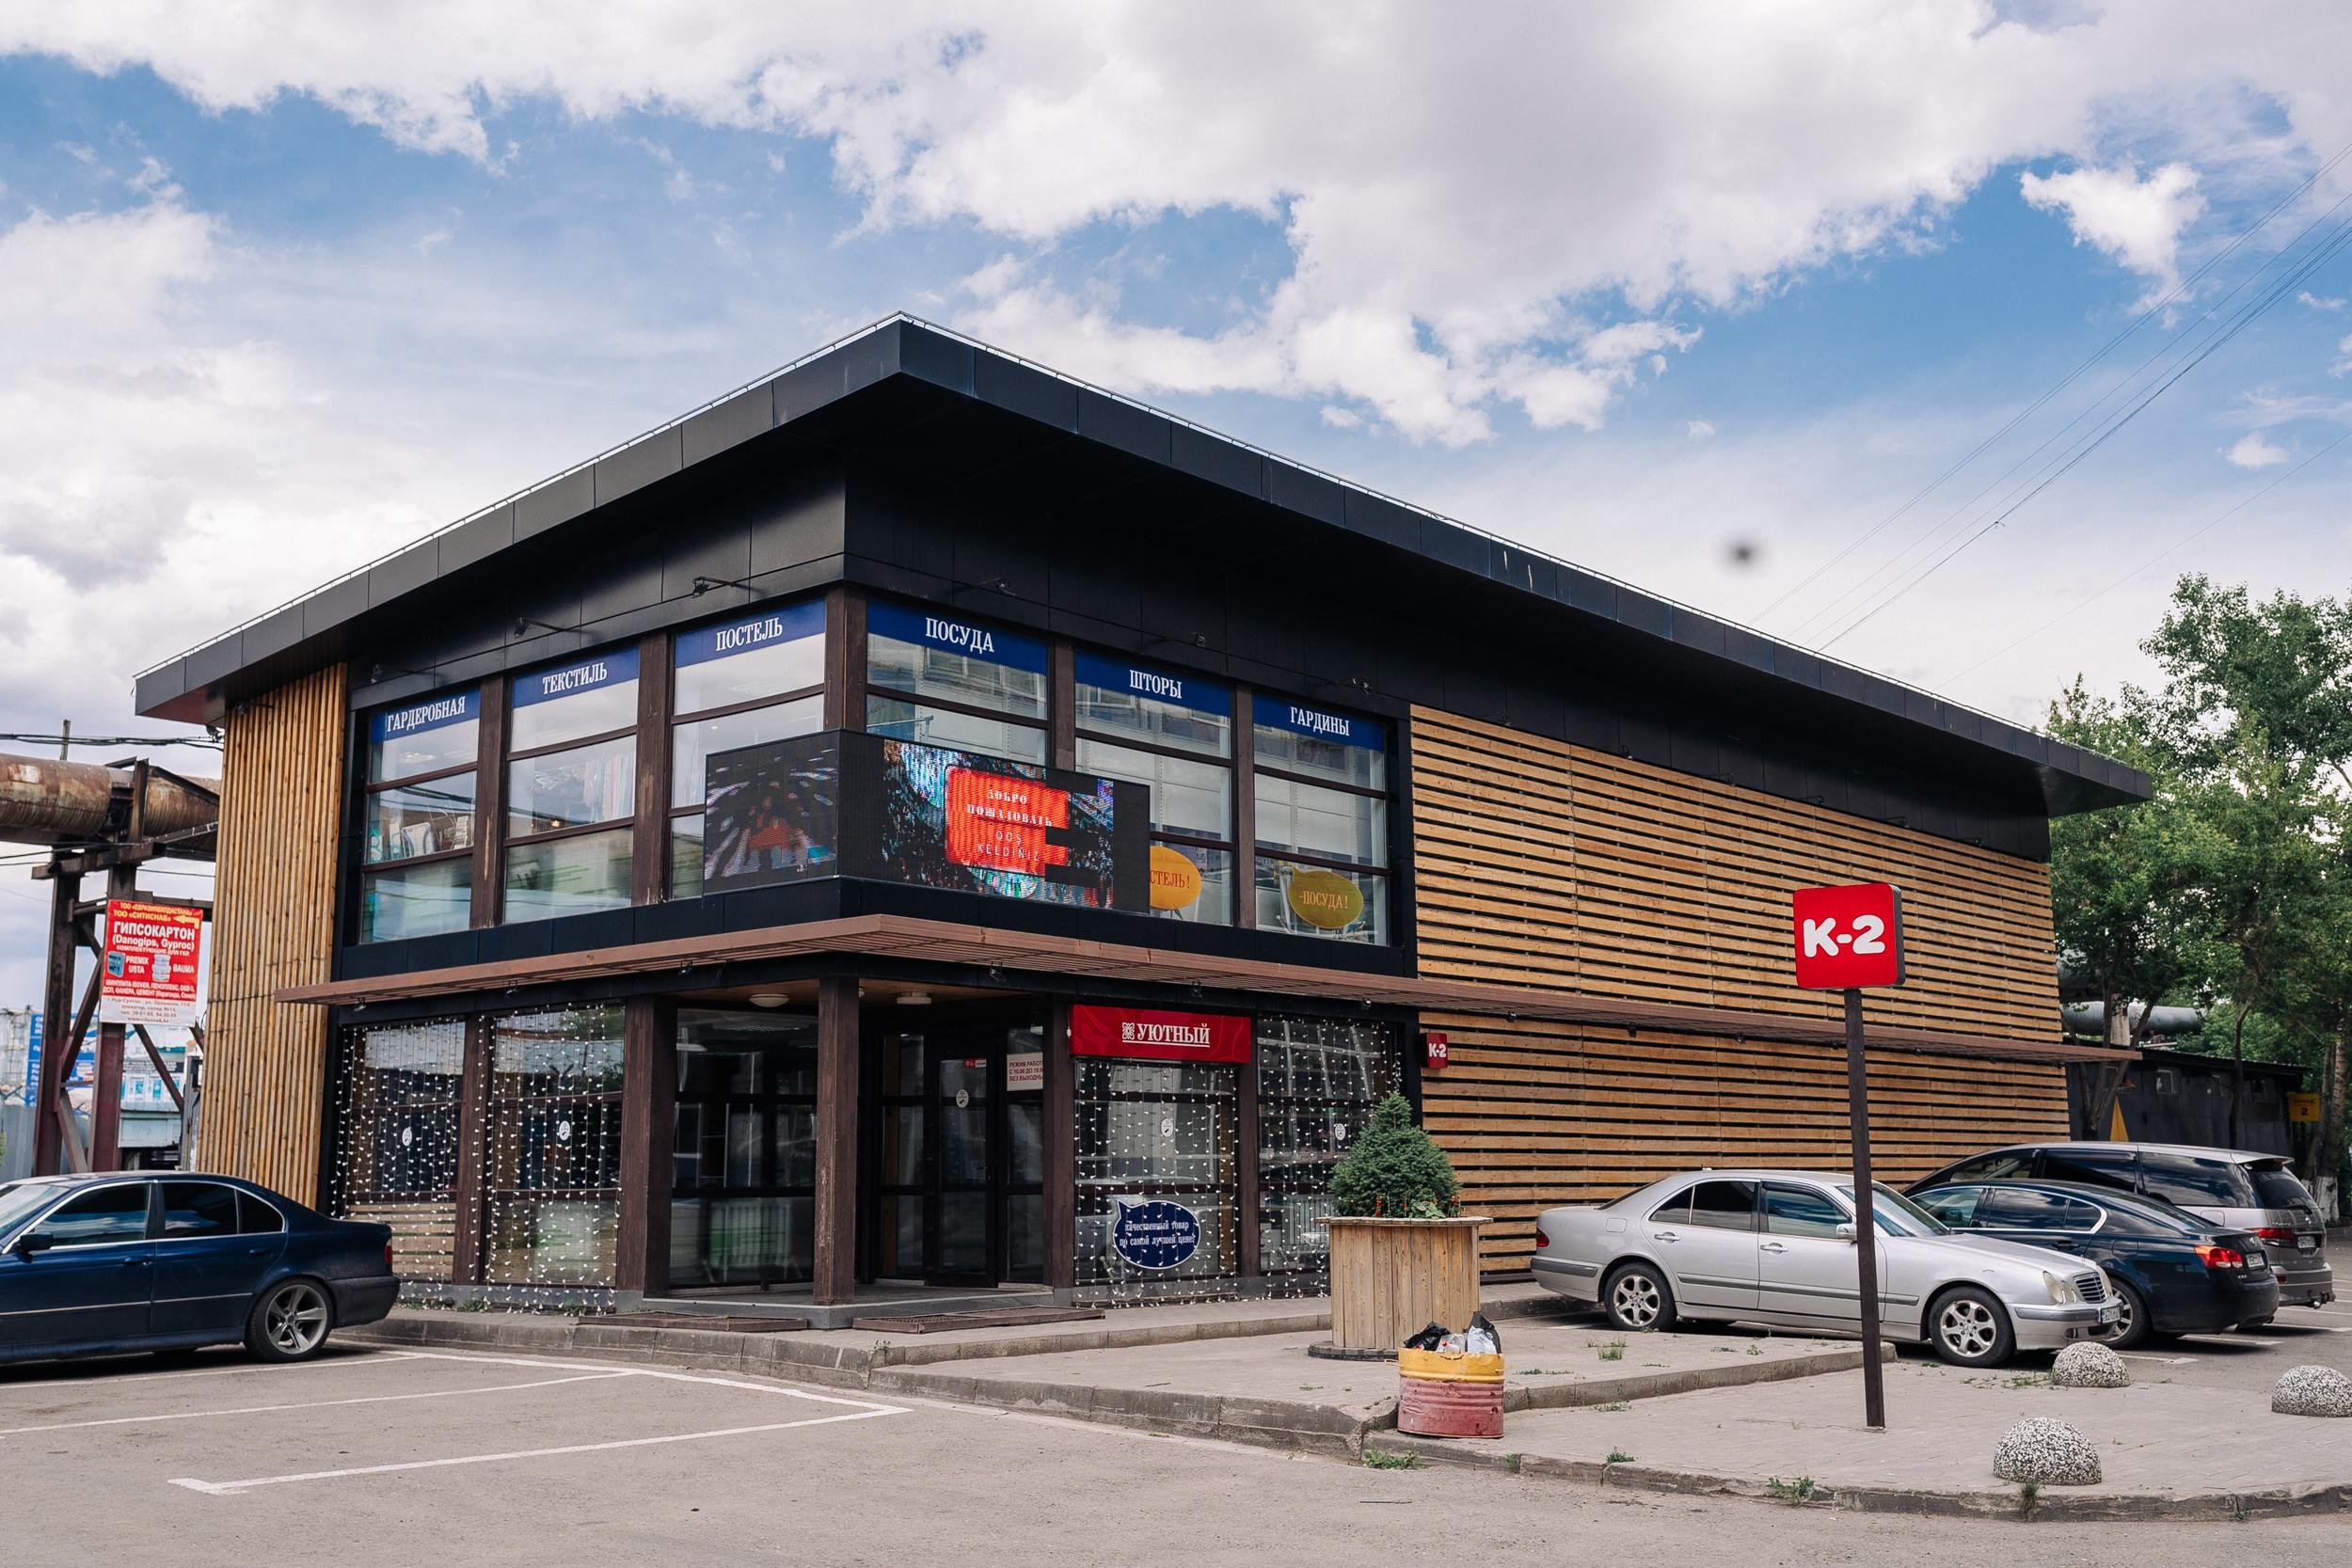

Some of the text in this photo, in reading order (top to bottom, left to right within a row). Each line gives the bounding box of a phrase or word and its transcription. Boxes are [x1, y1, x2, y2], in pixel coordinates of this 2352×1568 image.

[716, 617, 783, 651] ПОСТЕЛЬ
[926, 617, 994, 654] ПОСУДА
[542, 662, 608, 694] ТЕКСТИЛЬ
[1129, 669, 1182, 699] ШТОРЫ
[387, 696, 466, 732] ГАРДЕРОБНАЯ
[1290, 706, 1350, 736] ГАРДИНЫ
[113, 921, 196, 941] ГИПСОКАРТОН
[161, 939, 195, 952] Gyproc)
[1137, 1023, 1210, 1044] УЮТНЫЙ
